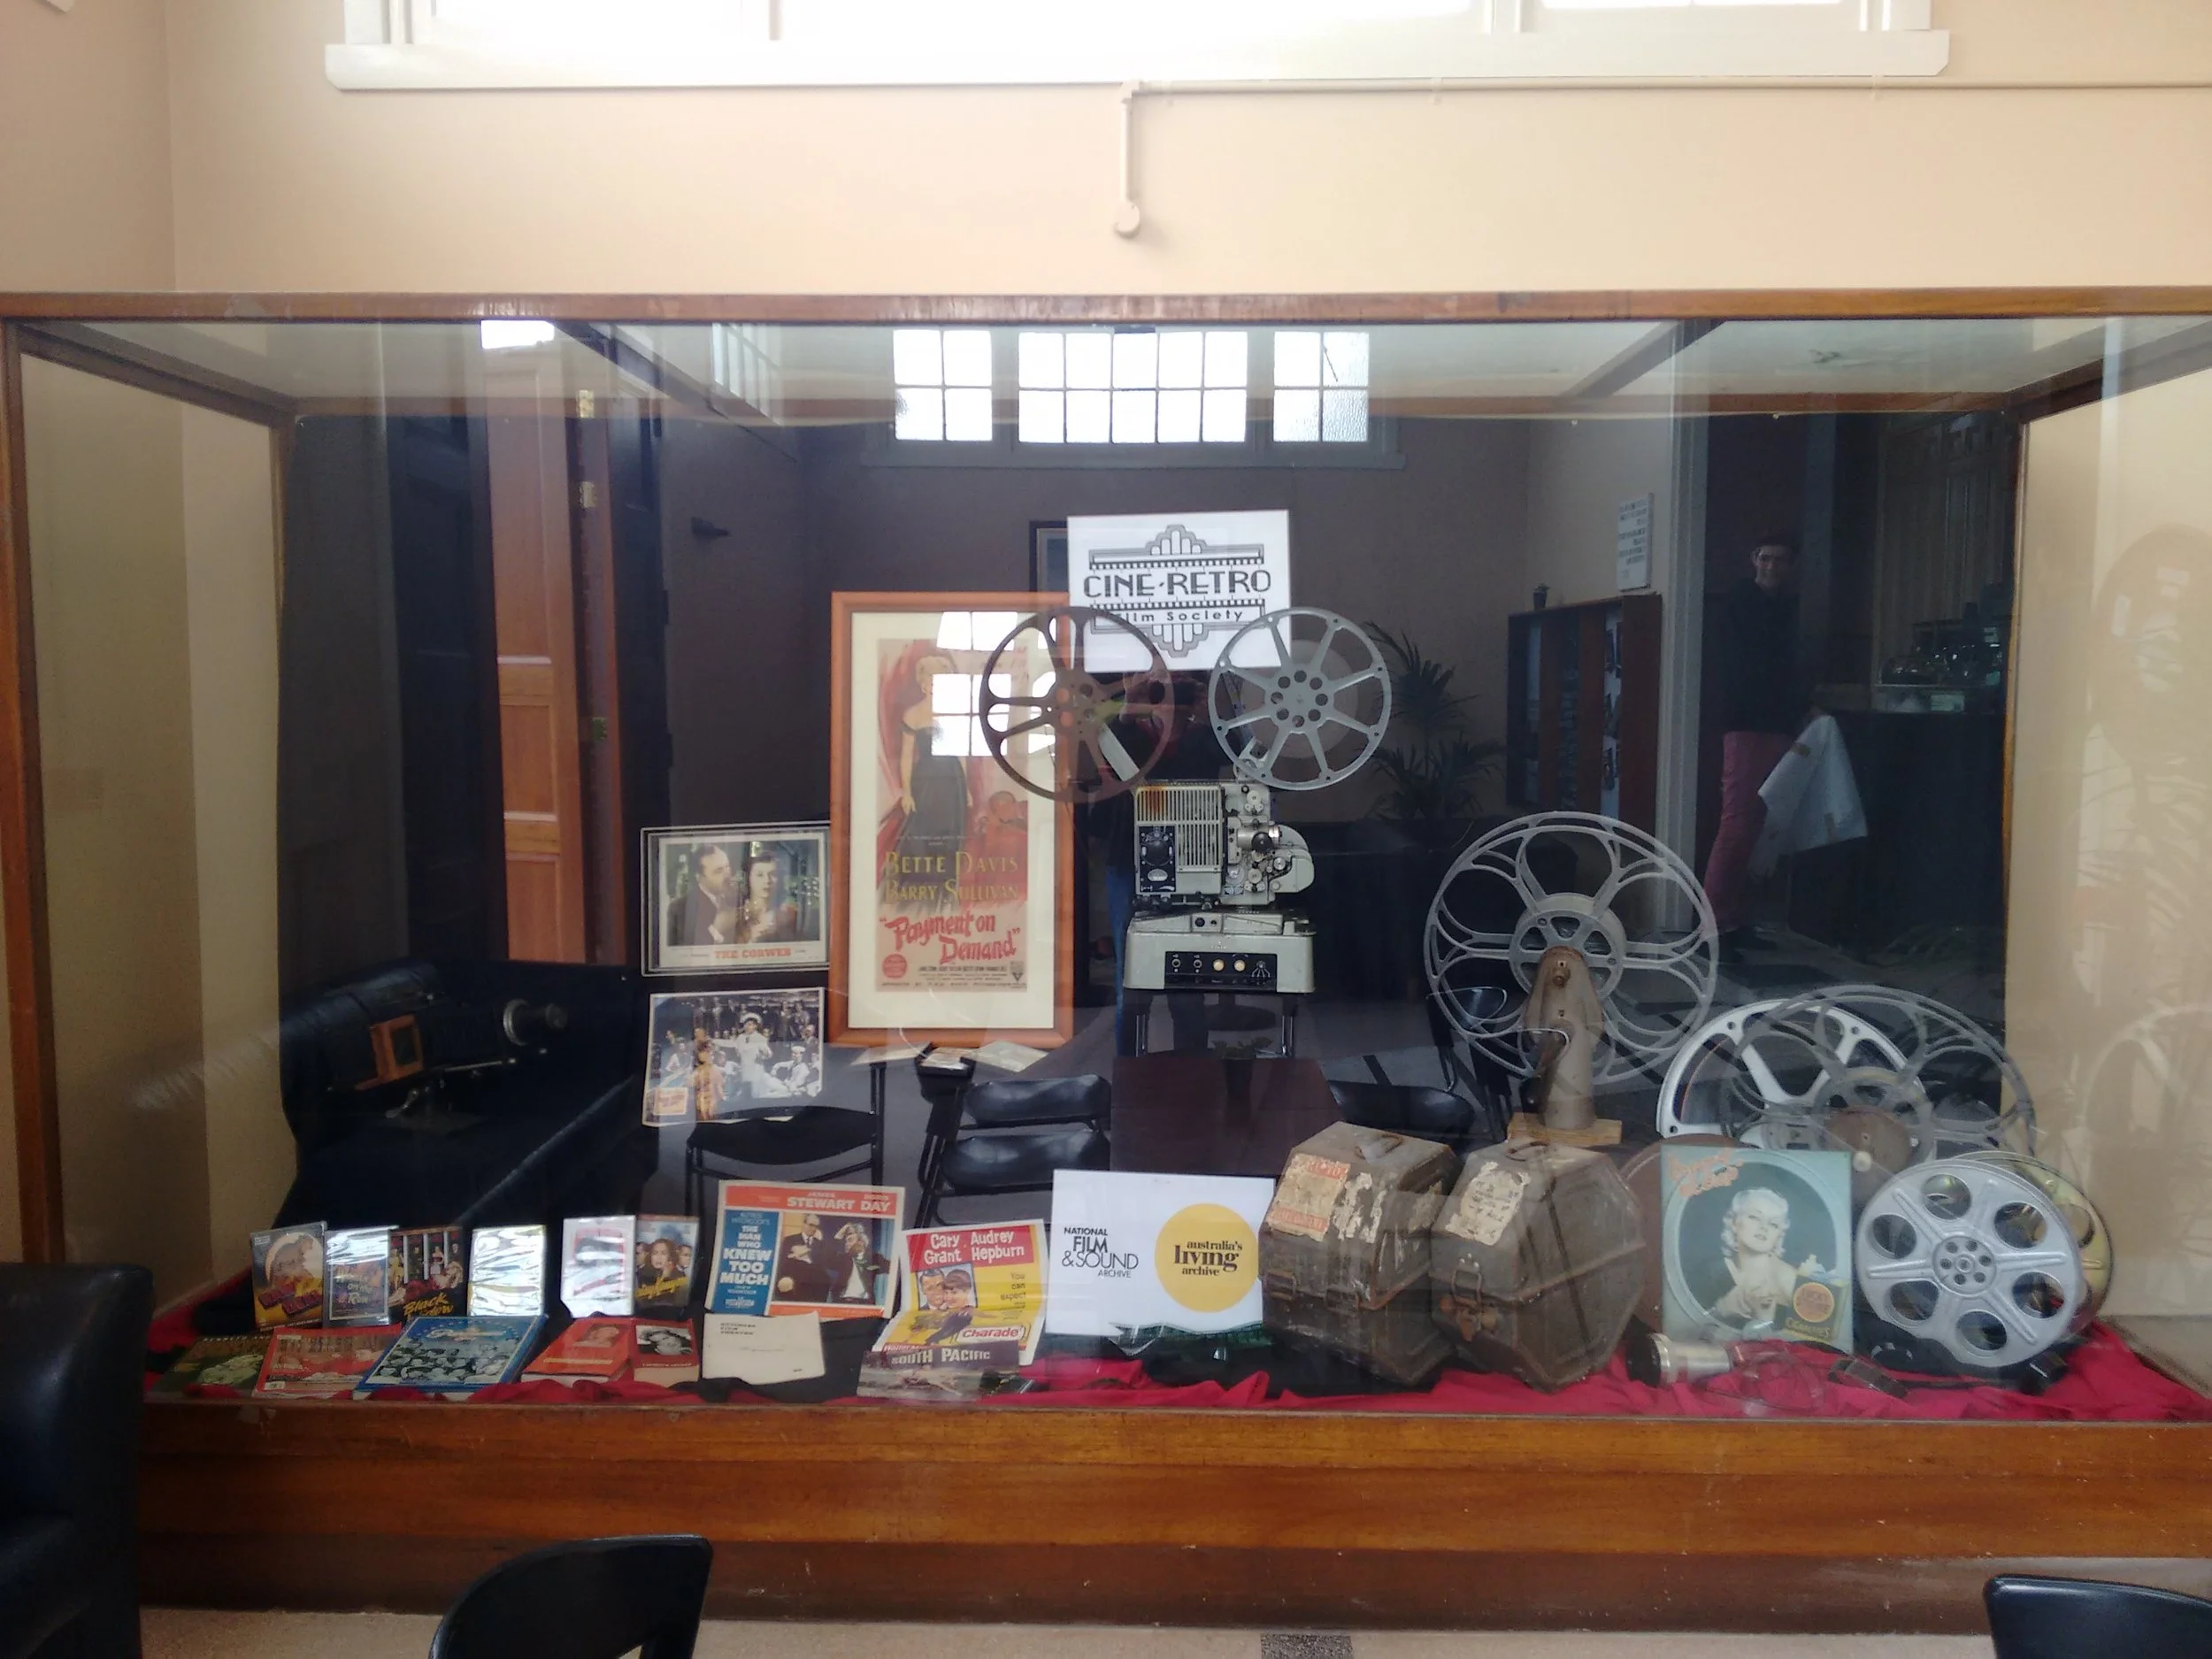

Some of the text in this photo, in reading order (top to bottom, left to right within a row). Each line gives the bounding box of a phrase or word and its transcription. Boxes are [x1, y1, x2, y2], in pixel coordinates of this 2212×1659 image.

[1117, 610, 1243, 622] ilm Society
[886, 851, 1018, 876] BETTE DAVIS
[886, 878, 1018, 903] BARRY SULLIVAN
[975, 914, 996, 933] on
[714, 949, 739, 959] THE
[787, 1196, 855, 1210] STEWART
[860, 1200, 890, 1212] DAY
[1064, 1226, 1109, 1236] NATIONAL
[737, 1240, 761, 1249] WHO
[930, 1230, 1015, 1249] Cary Audrey
[1072, 1235, 1109, 1254] FILM
[1187, 1240, 1243, 1251] australia's
[723, 1248, 773, 1262] KNEW
[924, 1245, 1025, 1265] Grant Hepburn
[1173, 1244, 1240, 1272] living
[728, 1260, 764, 1274] TOO
[1097, 1269, 1132, 1279] ARCHIVE
[1181, 1267, 1220, 1277] archive
[719, 1272, 769, 1286] MUCH
[962, 1326, 1018, 1339] Charade
[891, 1348, 991, 1364] SOUTH PACIFIC
